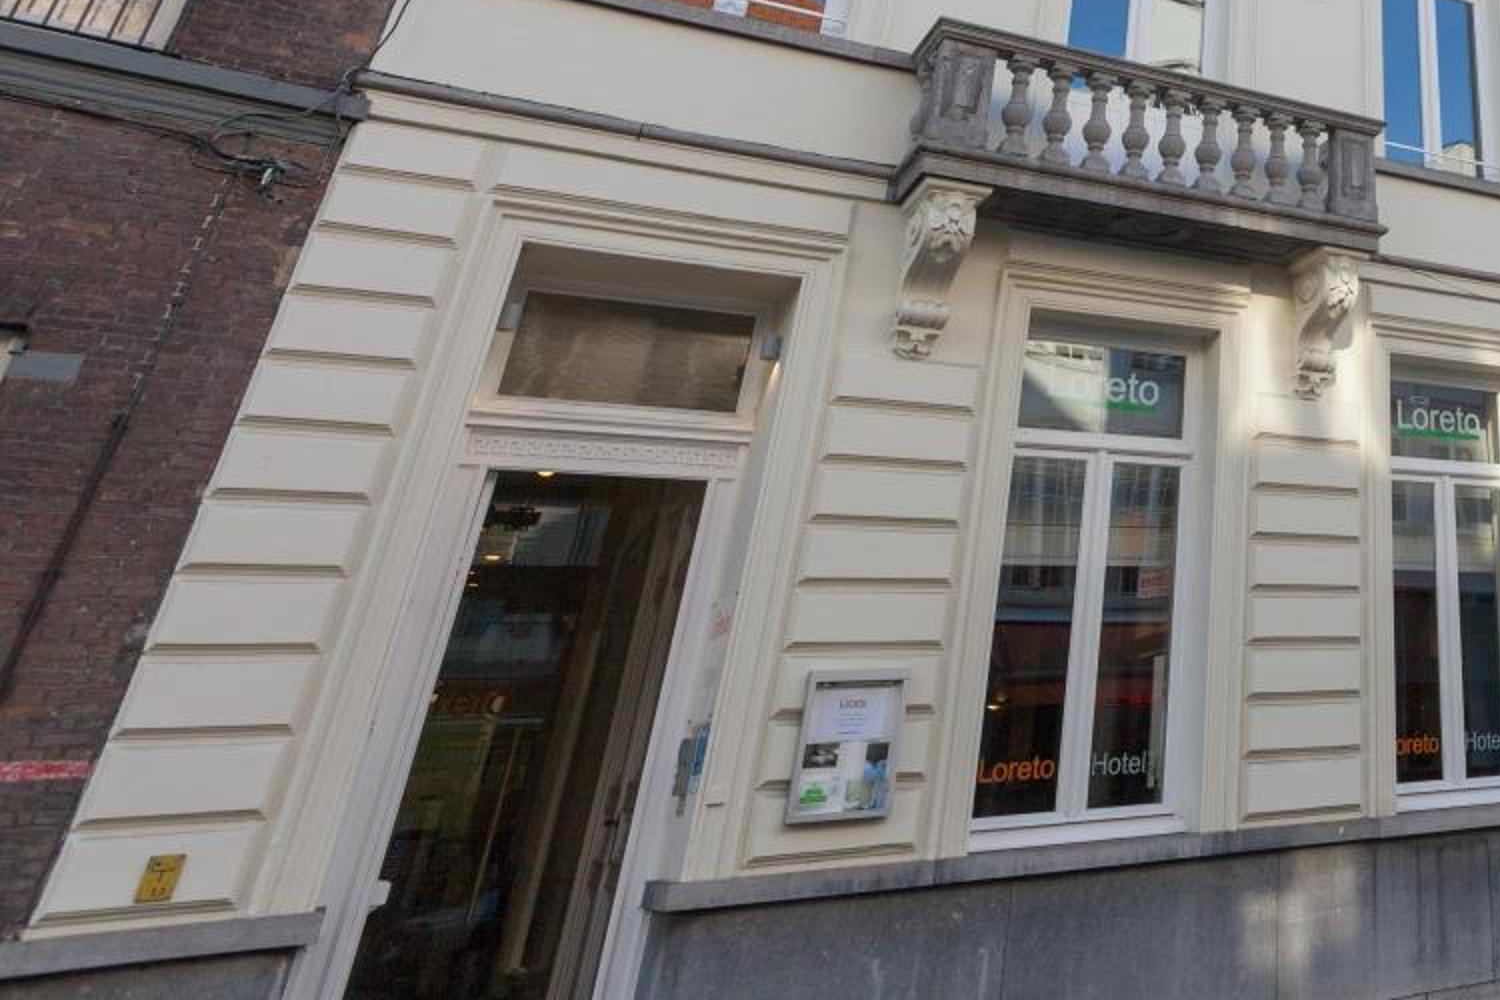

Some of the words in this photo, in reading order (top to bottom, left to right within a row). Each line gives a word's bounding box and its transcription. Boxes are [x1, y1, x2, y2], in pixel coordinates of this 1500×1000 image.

[1397, 399, 1481, 435] Loreto
[1396, 734, 1440, 755] oreto
[977, 756, 1056, 784] Loreto
[1091, 752, 1148, 777] Hotel
